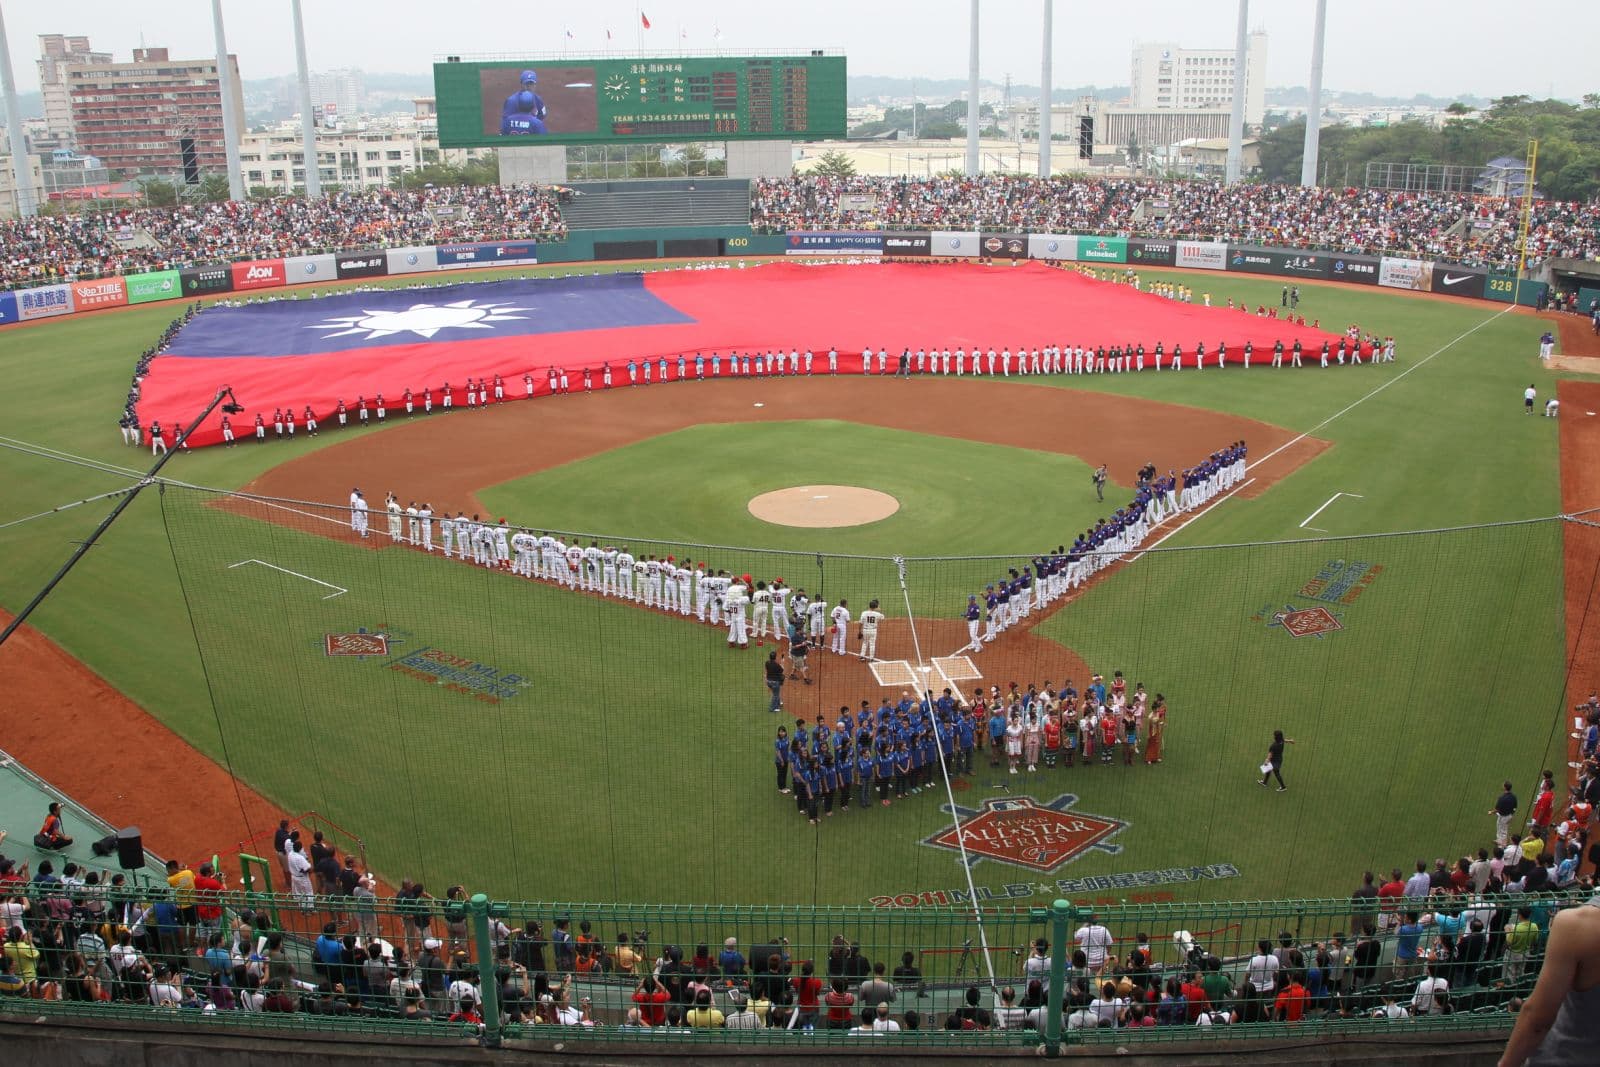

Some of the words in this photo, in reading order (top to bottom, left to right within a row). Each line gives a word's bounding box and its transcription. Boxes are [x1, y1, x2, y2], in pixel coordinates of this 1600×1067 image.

[728, 238, 748, 247] 400
[886, 239, 912, 247] Gillette
[1085, 250, 1118, 258] Heineken
[1183, 246, 1201, 257] 1111
[341, 260, 368, 269] Gillette
[1490, 279, 1513, 292] 328
[986, 816, 1049, 828] TAIWAN
[989, 833, 1069, 849] SERIES
[869, 890, 950, 908] 2011
[950, 883, 1035, 903] MLB
